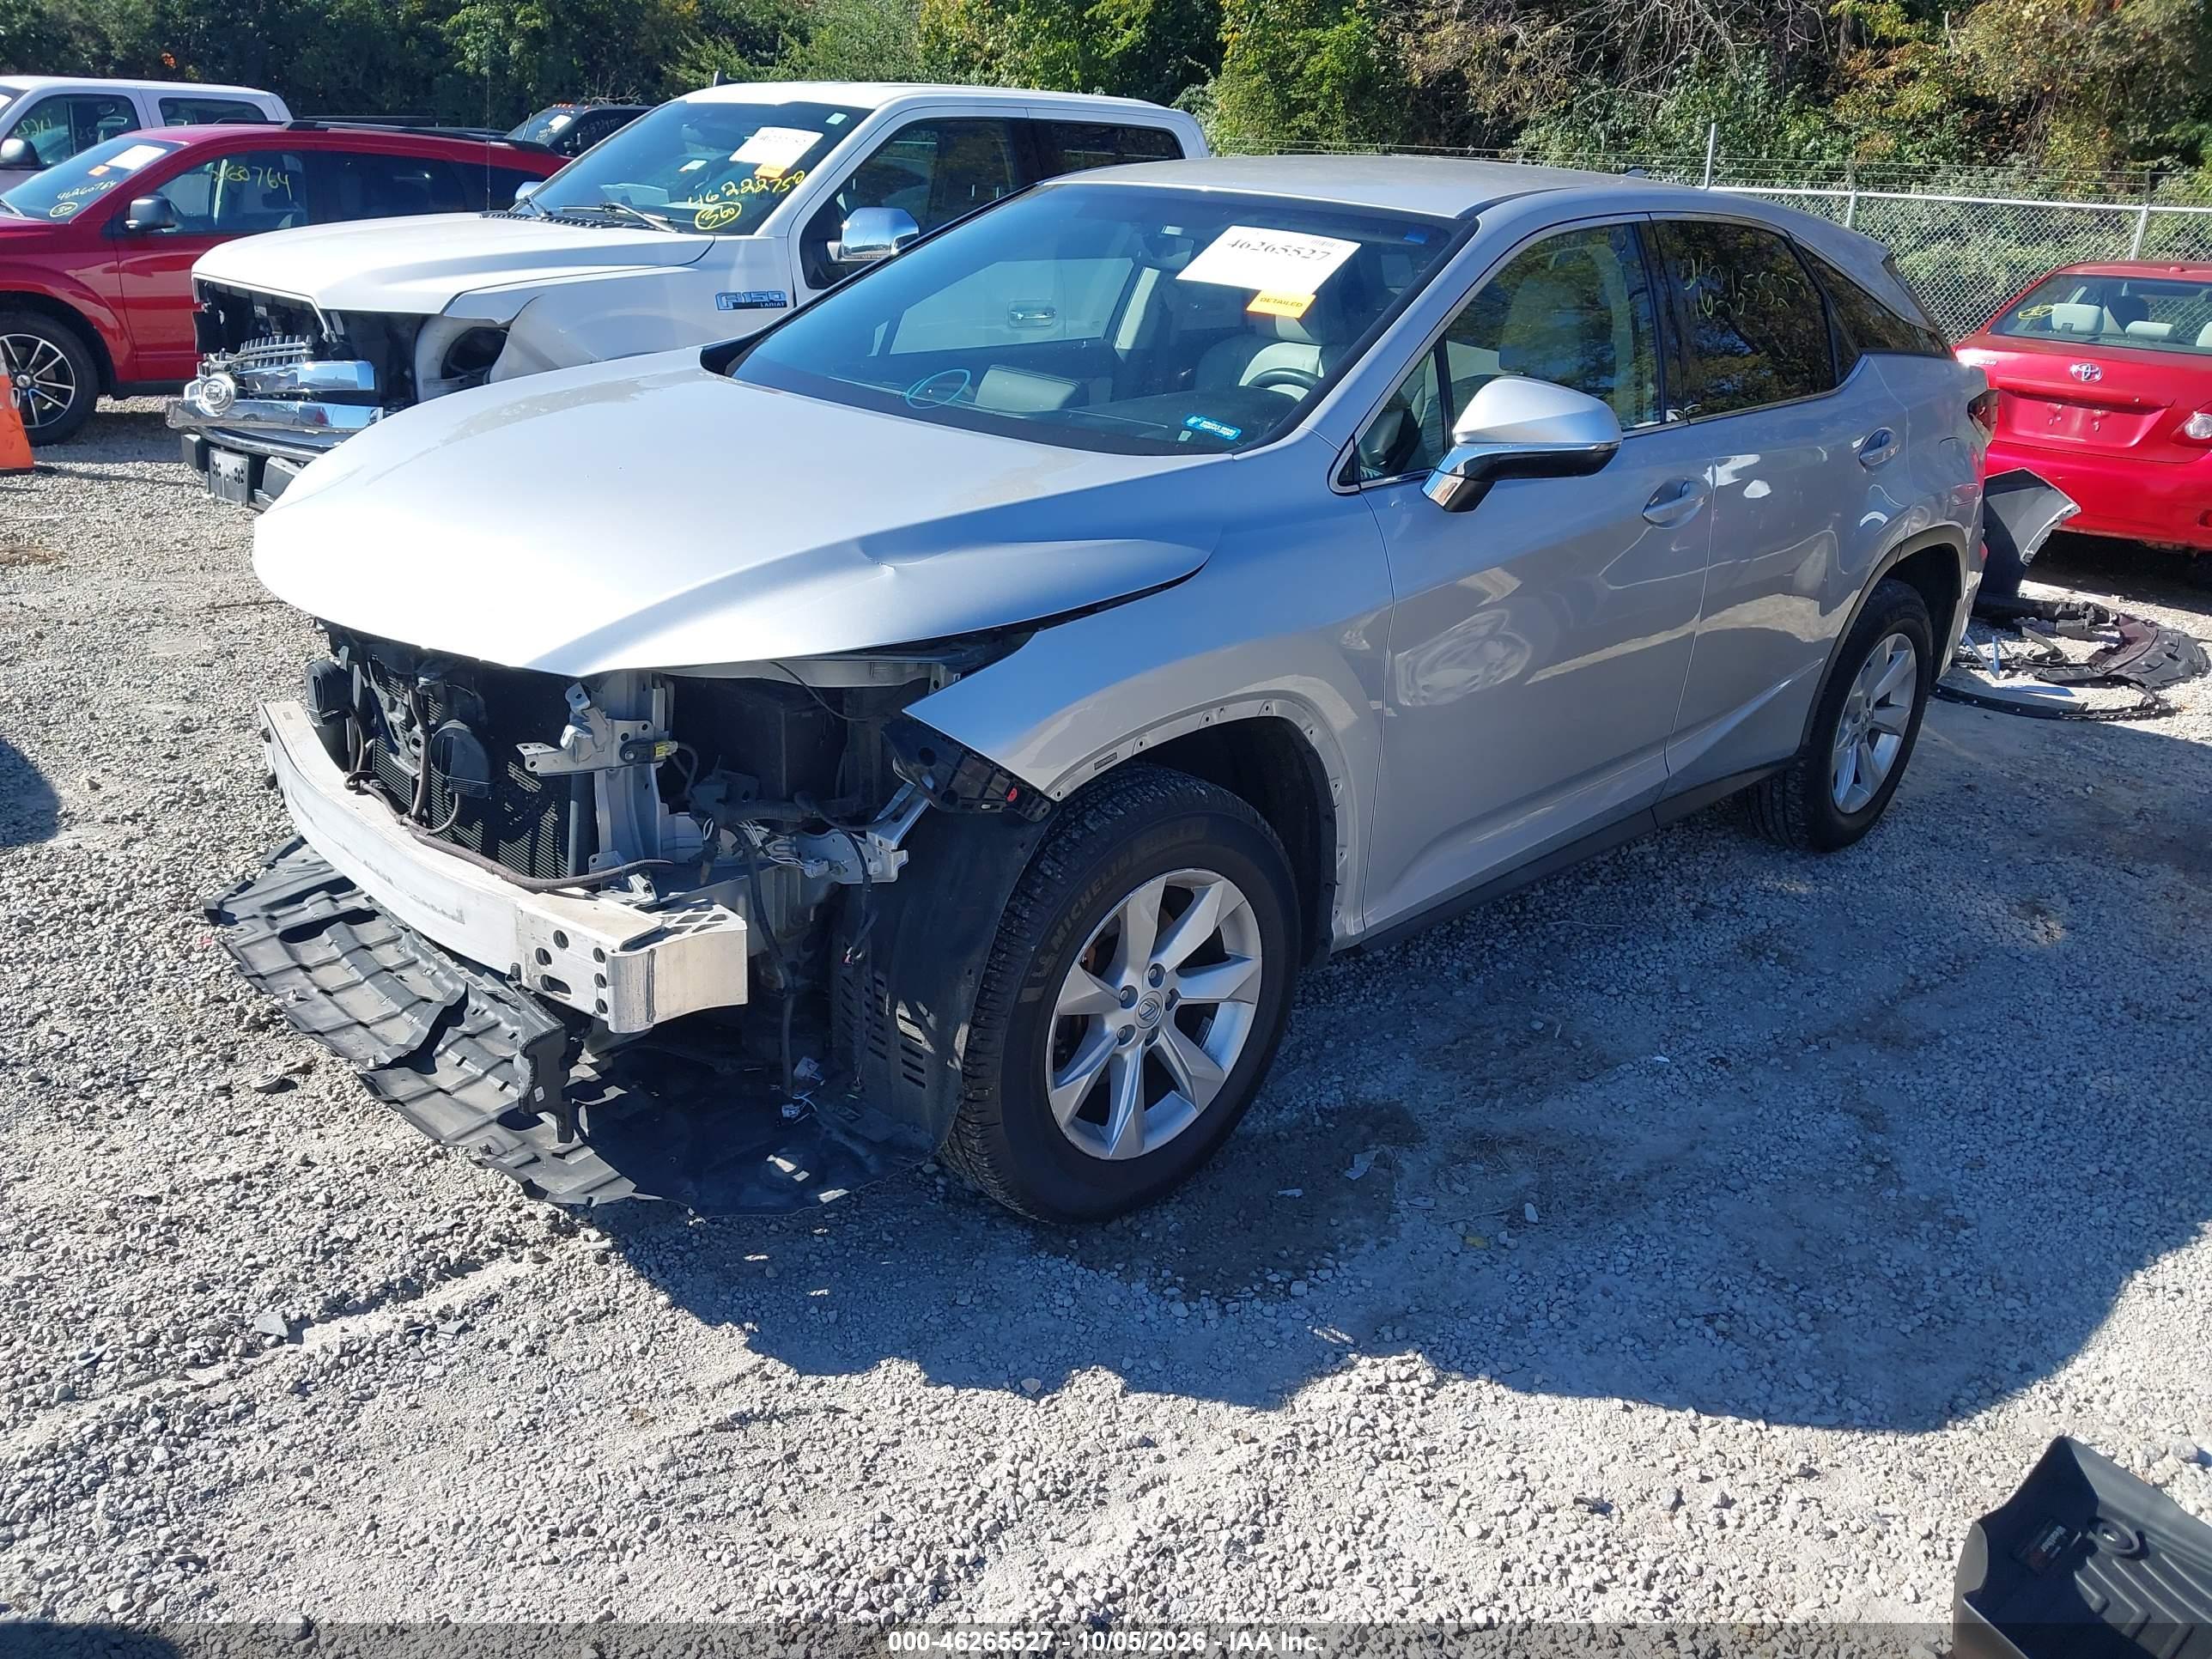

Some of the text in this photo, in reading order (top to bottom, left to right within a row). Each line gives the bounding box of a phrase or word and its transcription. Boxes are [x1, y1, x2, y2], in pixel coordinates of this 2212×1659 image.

[1227, 239, 1331, 261] 46265527
[1260, 297, 1304, 307] DETAILED
[1050, 851, 1133, 951] MICHELIN
